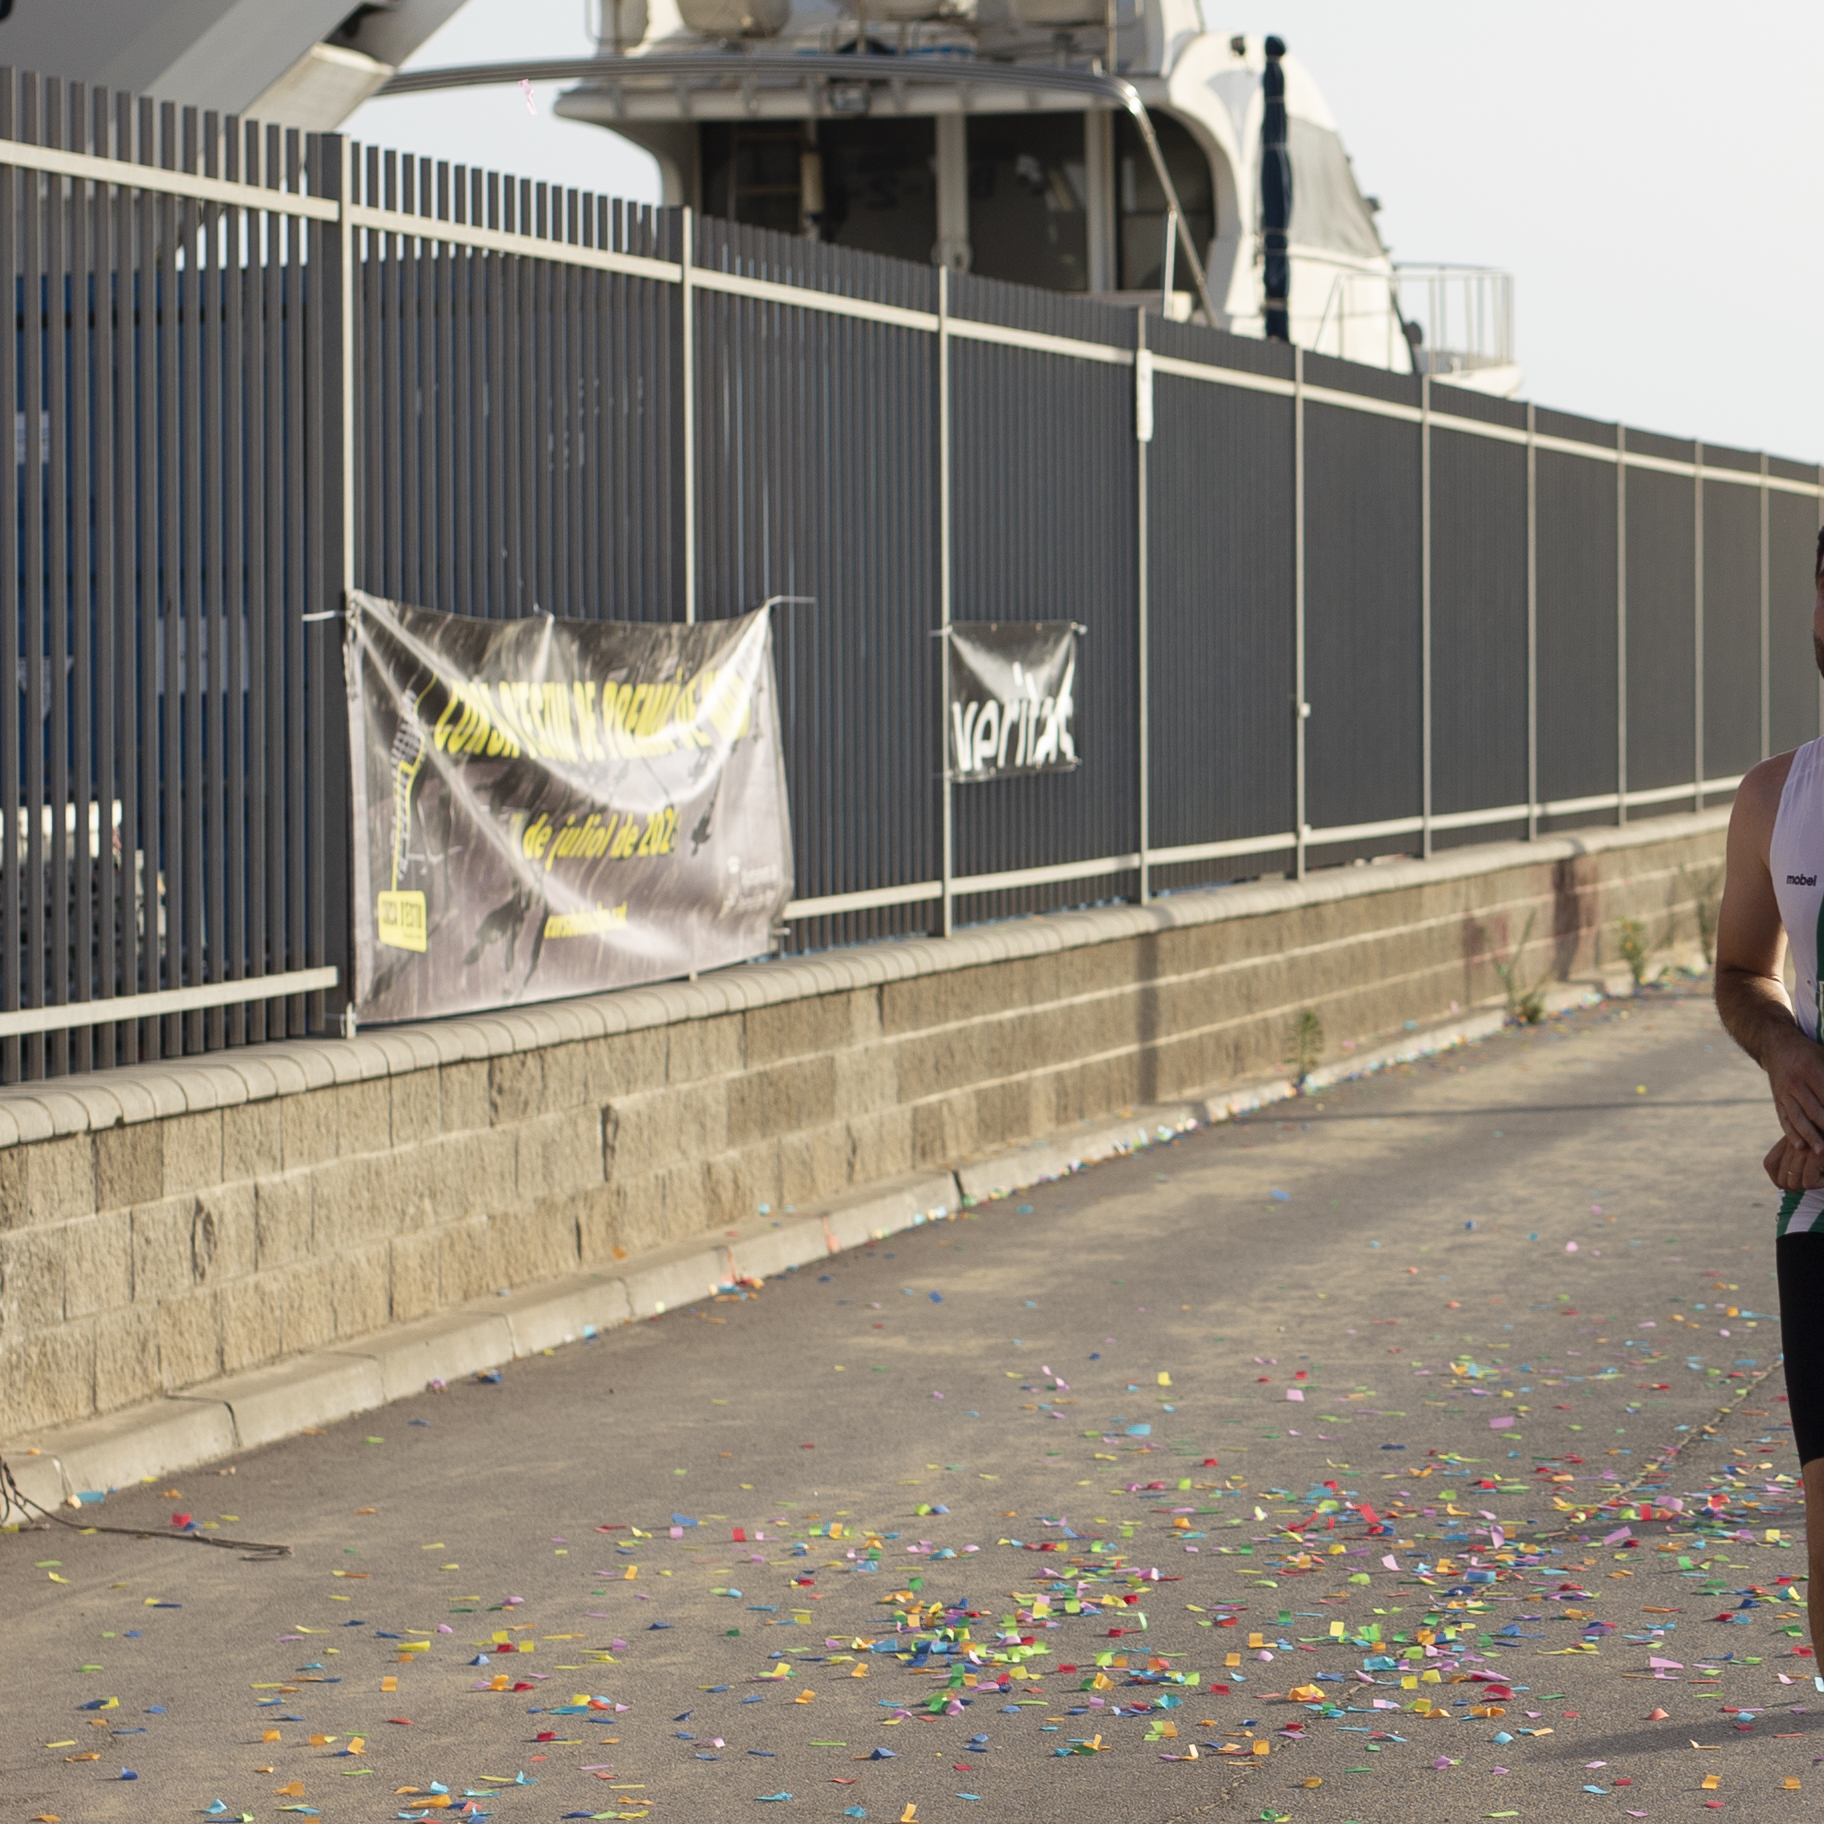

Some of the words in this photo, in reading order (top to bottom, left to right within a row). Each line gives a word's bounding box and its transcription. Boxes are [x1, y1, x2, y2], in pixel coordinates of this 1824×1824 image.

[522, 812, 553, 860] de
[545, 813, 618, 872] juliol
[610, 813, 639, 859] de
